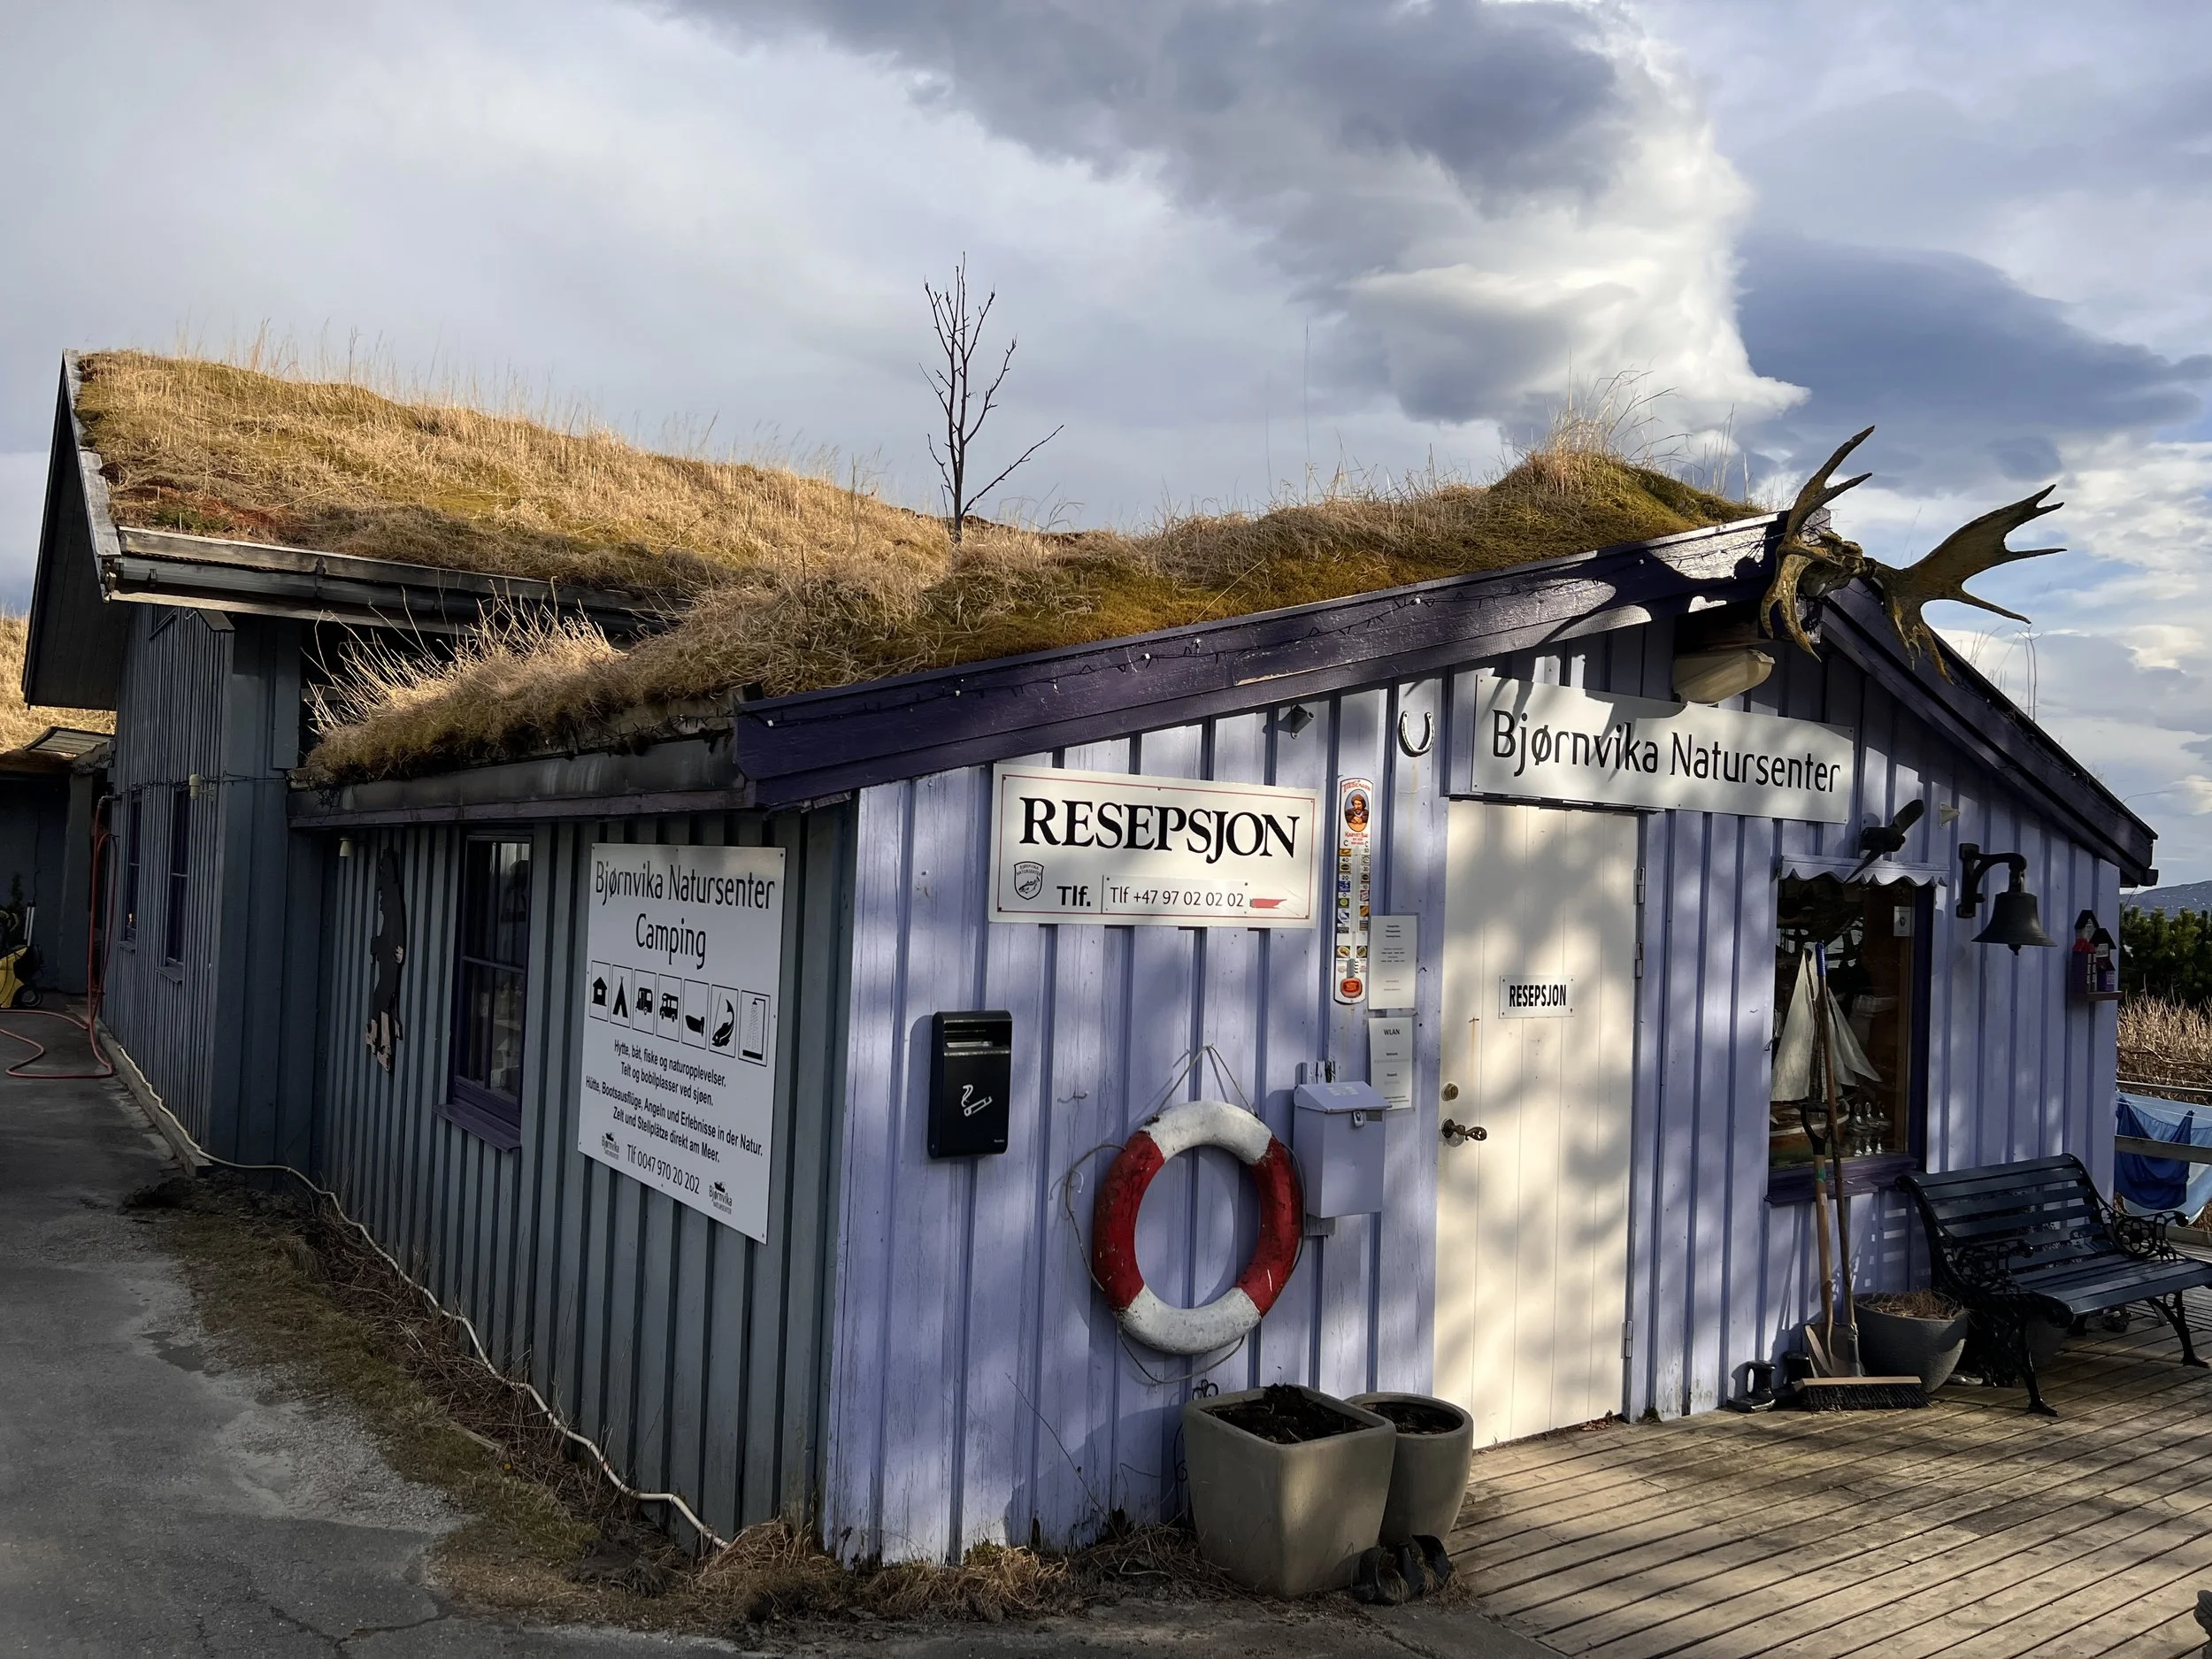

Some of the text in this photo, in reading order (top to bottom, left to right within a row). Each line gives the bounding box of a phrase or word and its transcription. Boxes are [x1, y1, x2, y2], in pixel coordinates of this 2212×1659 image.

[1493, 709, 1840, 793] Bjørnvika Natursenter
[1019, 797, 1300, 864] RESEPSJON
[595, 860, 775, 910] Bjørnvika Natursenter
[1056, 886, 1091, 907] Tlf.
[1110, 887, 1244, 907] Tlf +47 97 02 02 02
[635, 913, 706, 970] Camping
[1509, 984, 1566, 1007] RESEPSJON
[614, 1039, 630, 1058] Hytte,
[644, 1048, 657, 1065] fiske
[659, 1056, 667, 1071] og
[669, 1059, 726, 1087] naturopplevelser.
[621, 1061, 713, 1106] Telt og bobilplasser ved sjøen.
[586, 1075, 763, 1156] Hütte, Bootsausflüge, Angeln und Erlebnisse in der Natur.
[613, 1106, 720, 1163] Zelt und Stellplätze direkt am Meer.
[627, 1144, 637, 1164] Tlf
[637, 1151, 657, 1172] 0047
[657, 1160, 671, 1180] 970
[672, 1166, 683, 1186] 20
[685, 1172, 700, 1194] 202
